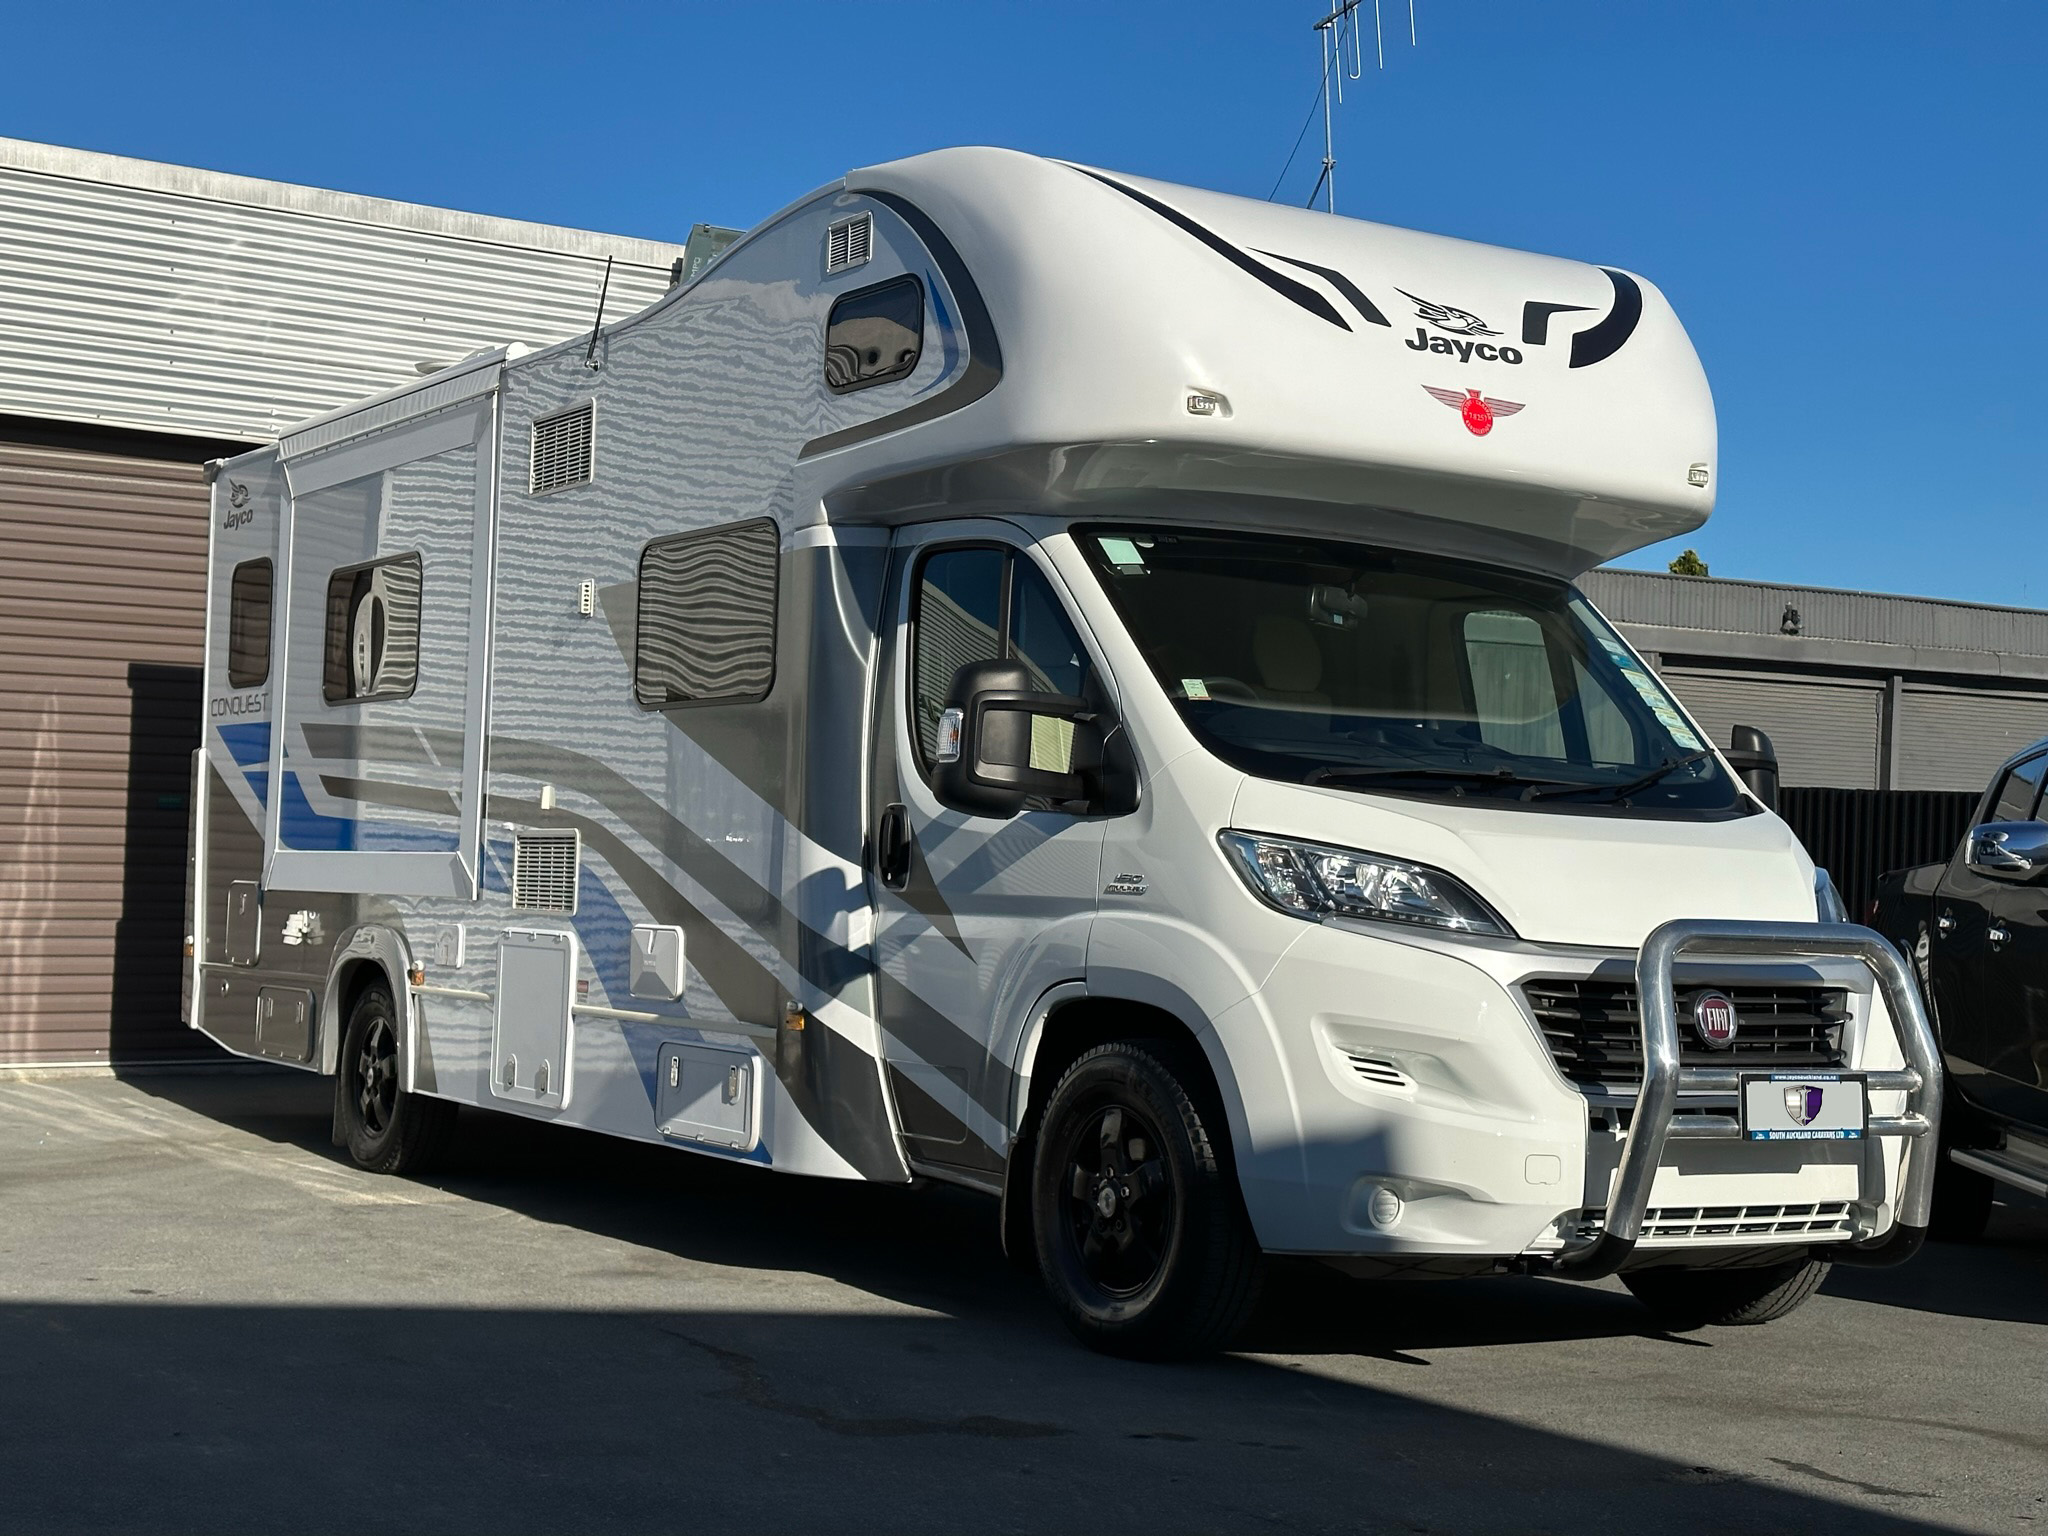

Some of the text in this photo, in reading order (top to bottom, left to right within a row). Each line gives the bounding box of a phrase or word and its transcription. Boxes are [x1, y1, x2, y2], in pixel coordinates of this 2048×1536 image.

[1404, 328, 1523, 365] Jayco
[223, 508, 254, 531] Jayco
[211, 692, 269, 717] CONQUEST
[1706, 1007, 1729, 1031] FIAT
[1769, 1131, 1785, 1140] SOUTH
[1786, 1131, 1811, 1140] AUCKLAND
[1811, 1131, 1836, 1139] CARAVANS
[1836, 1130, 1845, 1139] LTD
